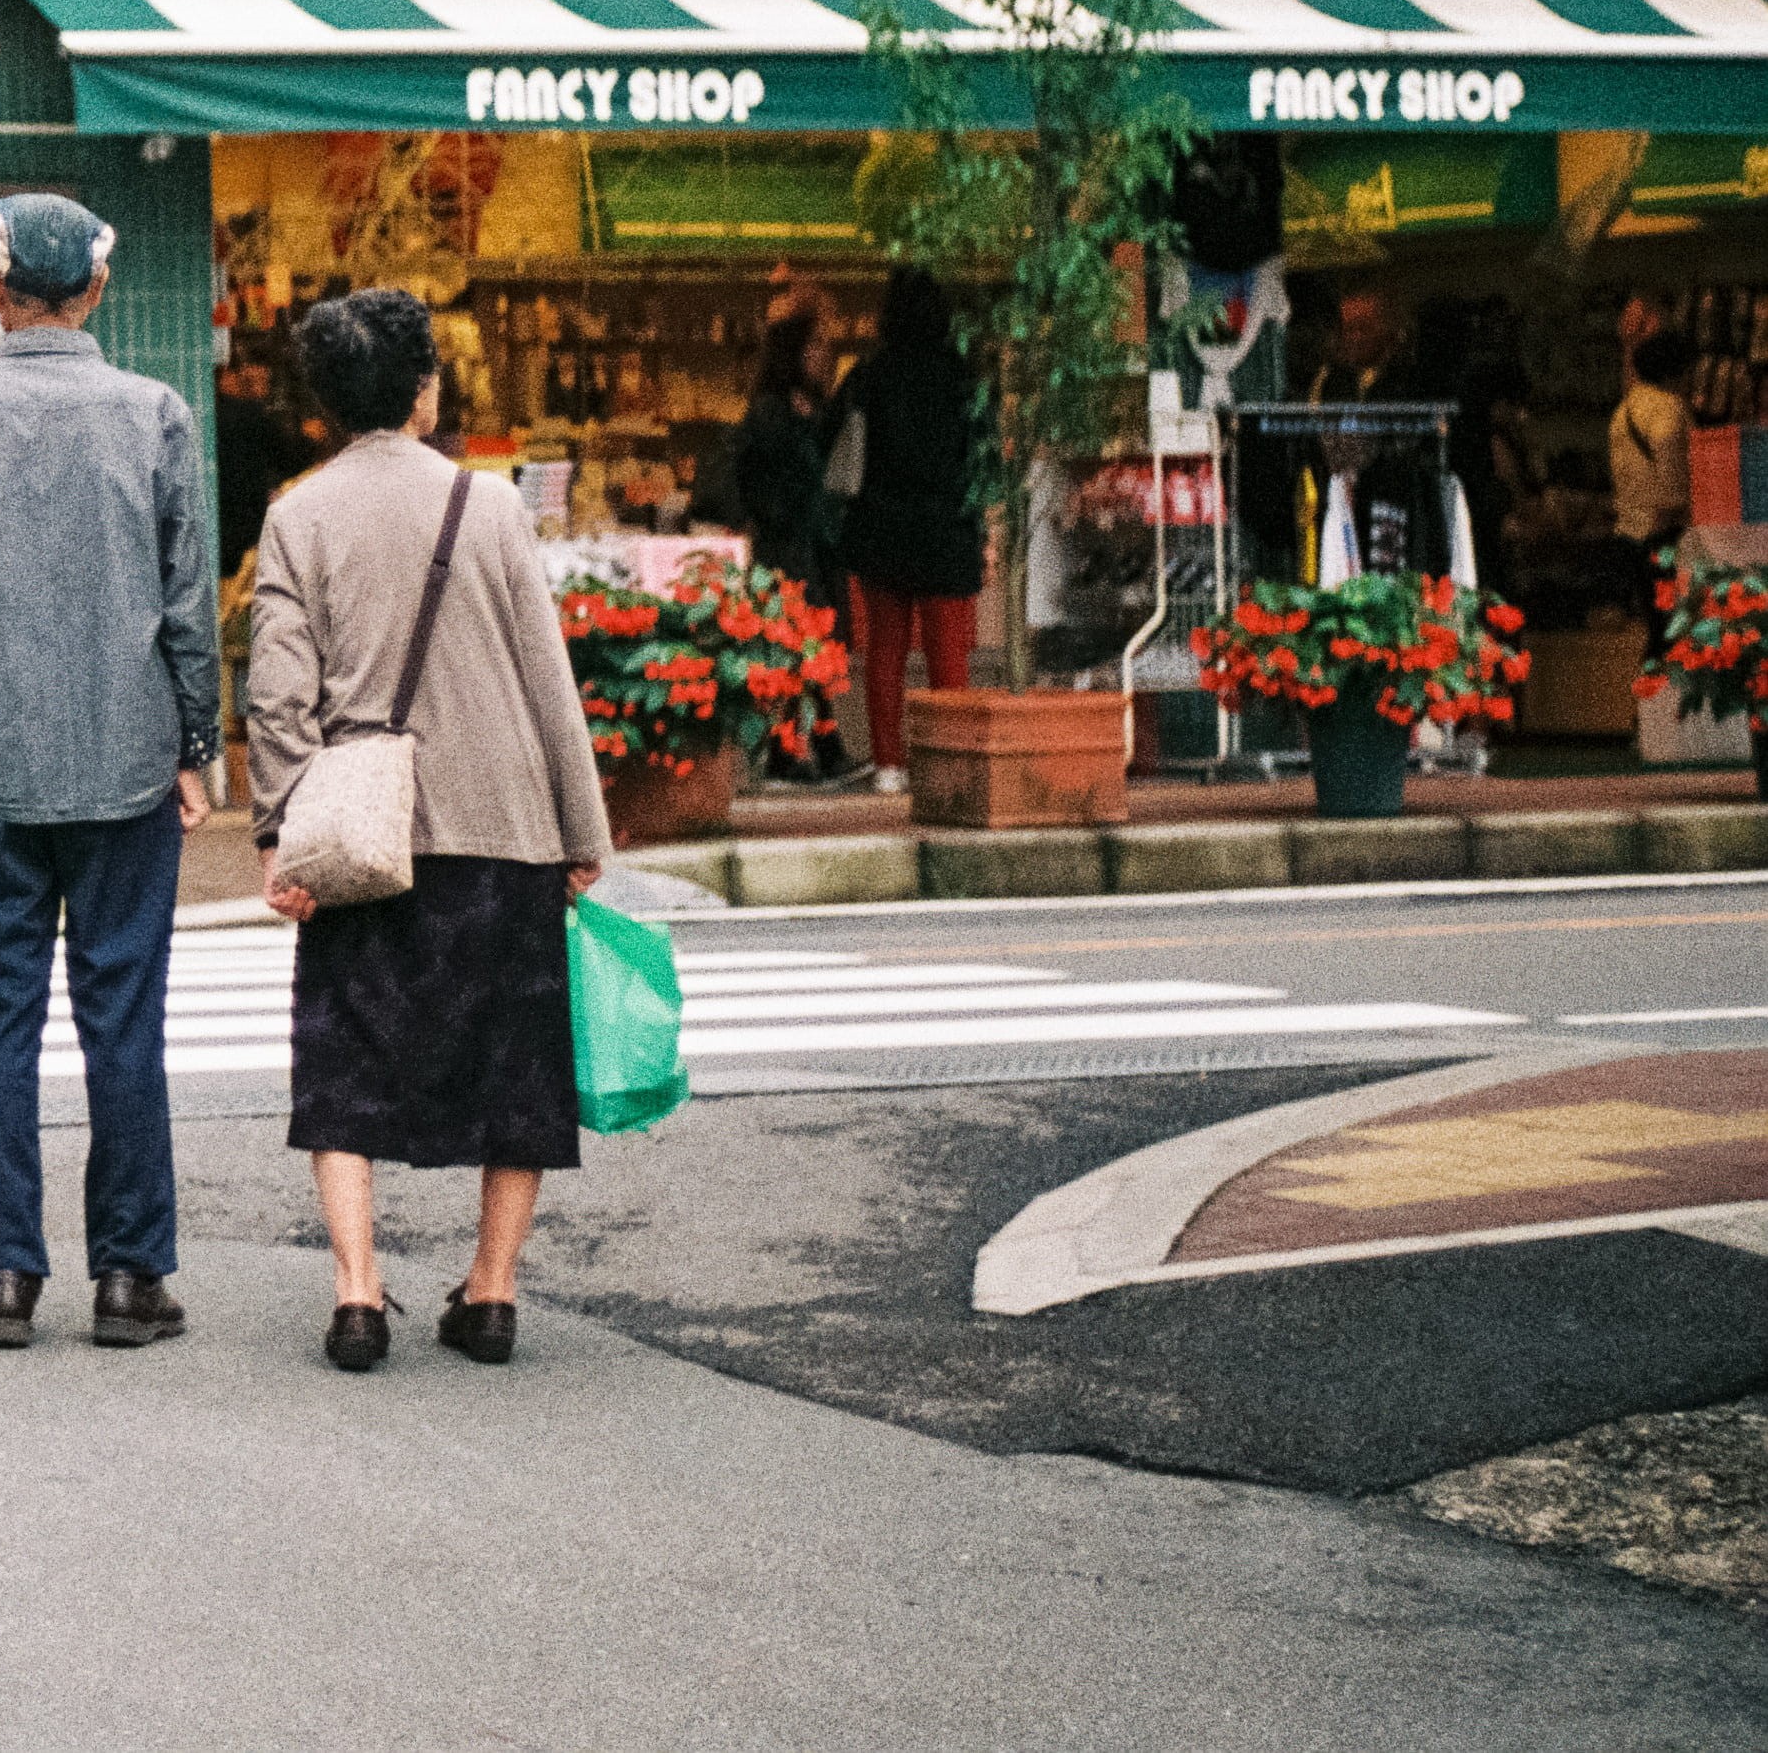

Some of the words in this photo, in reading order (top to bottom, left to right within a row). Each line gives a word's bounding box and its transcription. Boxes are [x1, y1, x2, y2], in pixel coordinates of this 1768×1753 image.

[466, 67, 619, 122] FANCY
[628, 67, 765, 123] SHOP
[1249, 67, 1390, 122] FANCY
[1398, 69, 1525, 123] SHOP
